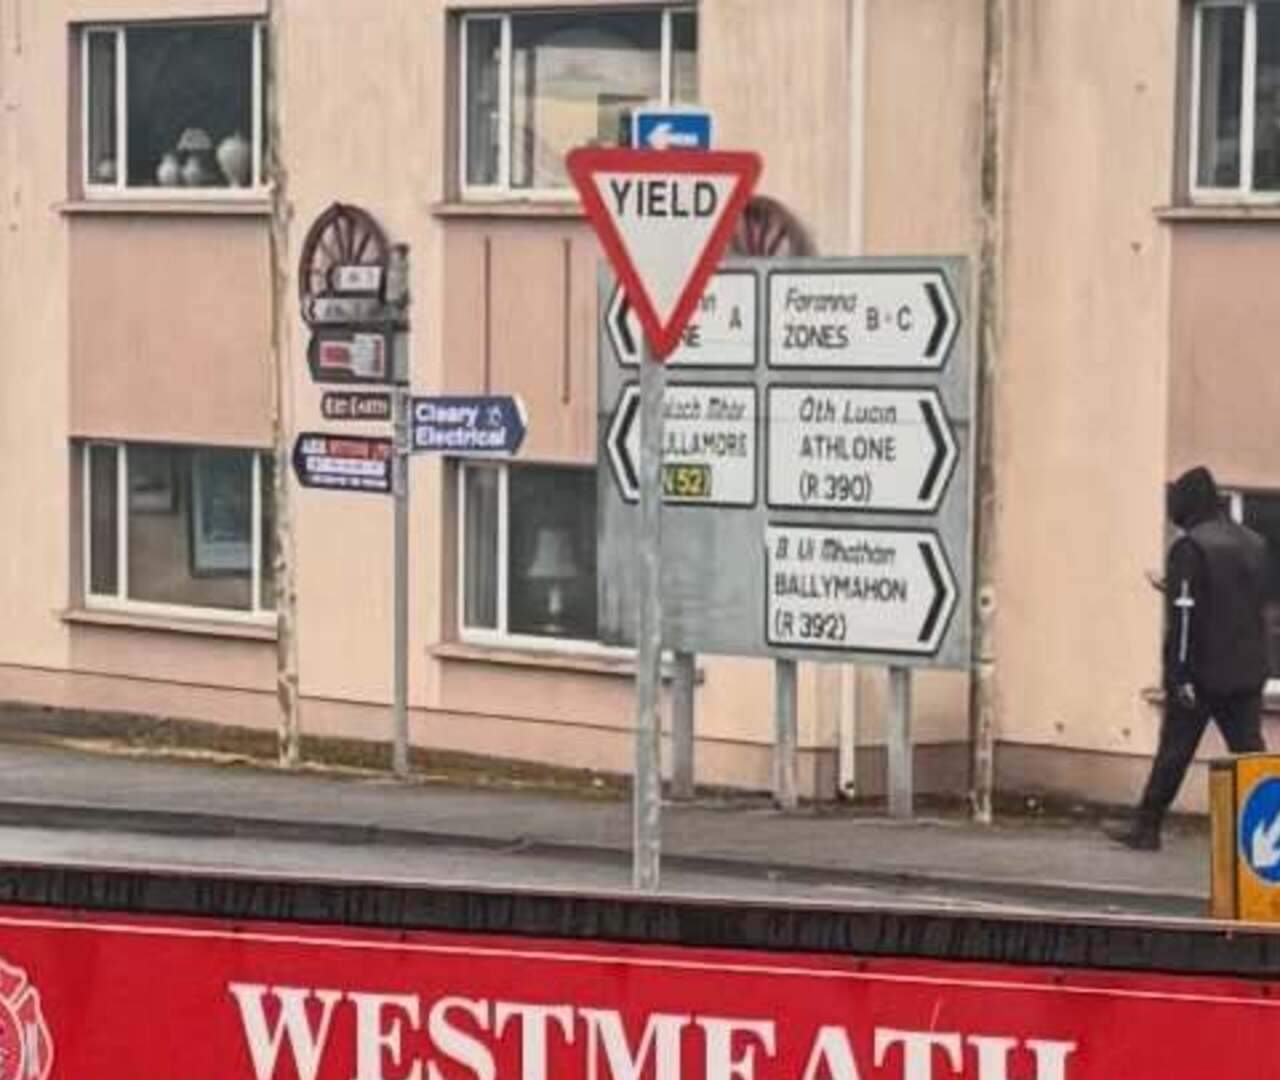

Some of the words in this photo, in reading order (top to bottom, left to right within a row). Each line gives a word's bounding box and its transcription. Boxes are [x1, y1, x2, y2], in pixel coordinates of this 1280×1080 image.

[610, 178, 718, 218] YIELD
[728, 303, 743, 331] A
[782, 324, 850, 350] ZONES
[414, 403, 480, 428] Cleary
[414, 425, 507, 449] Electrical
[799, 433, 898, 462] ATHLONE
[824, 471, 873, 502] 390)
[774, 572, 908, 603] BALLYMAHON
[798, 610, 847, 642] 392)
